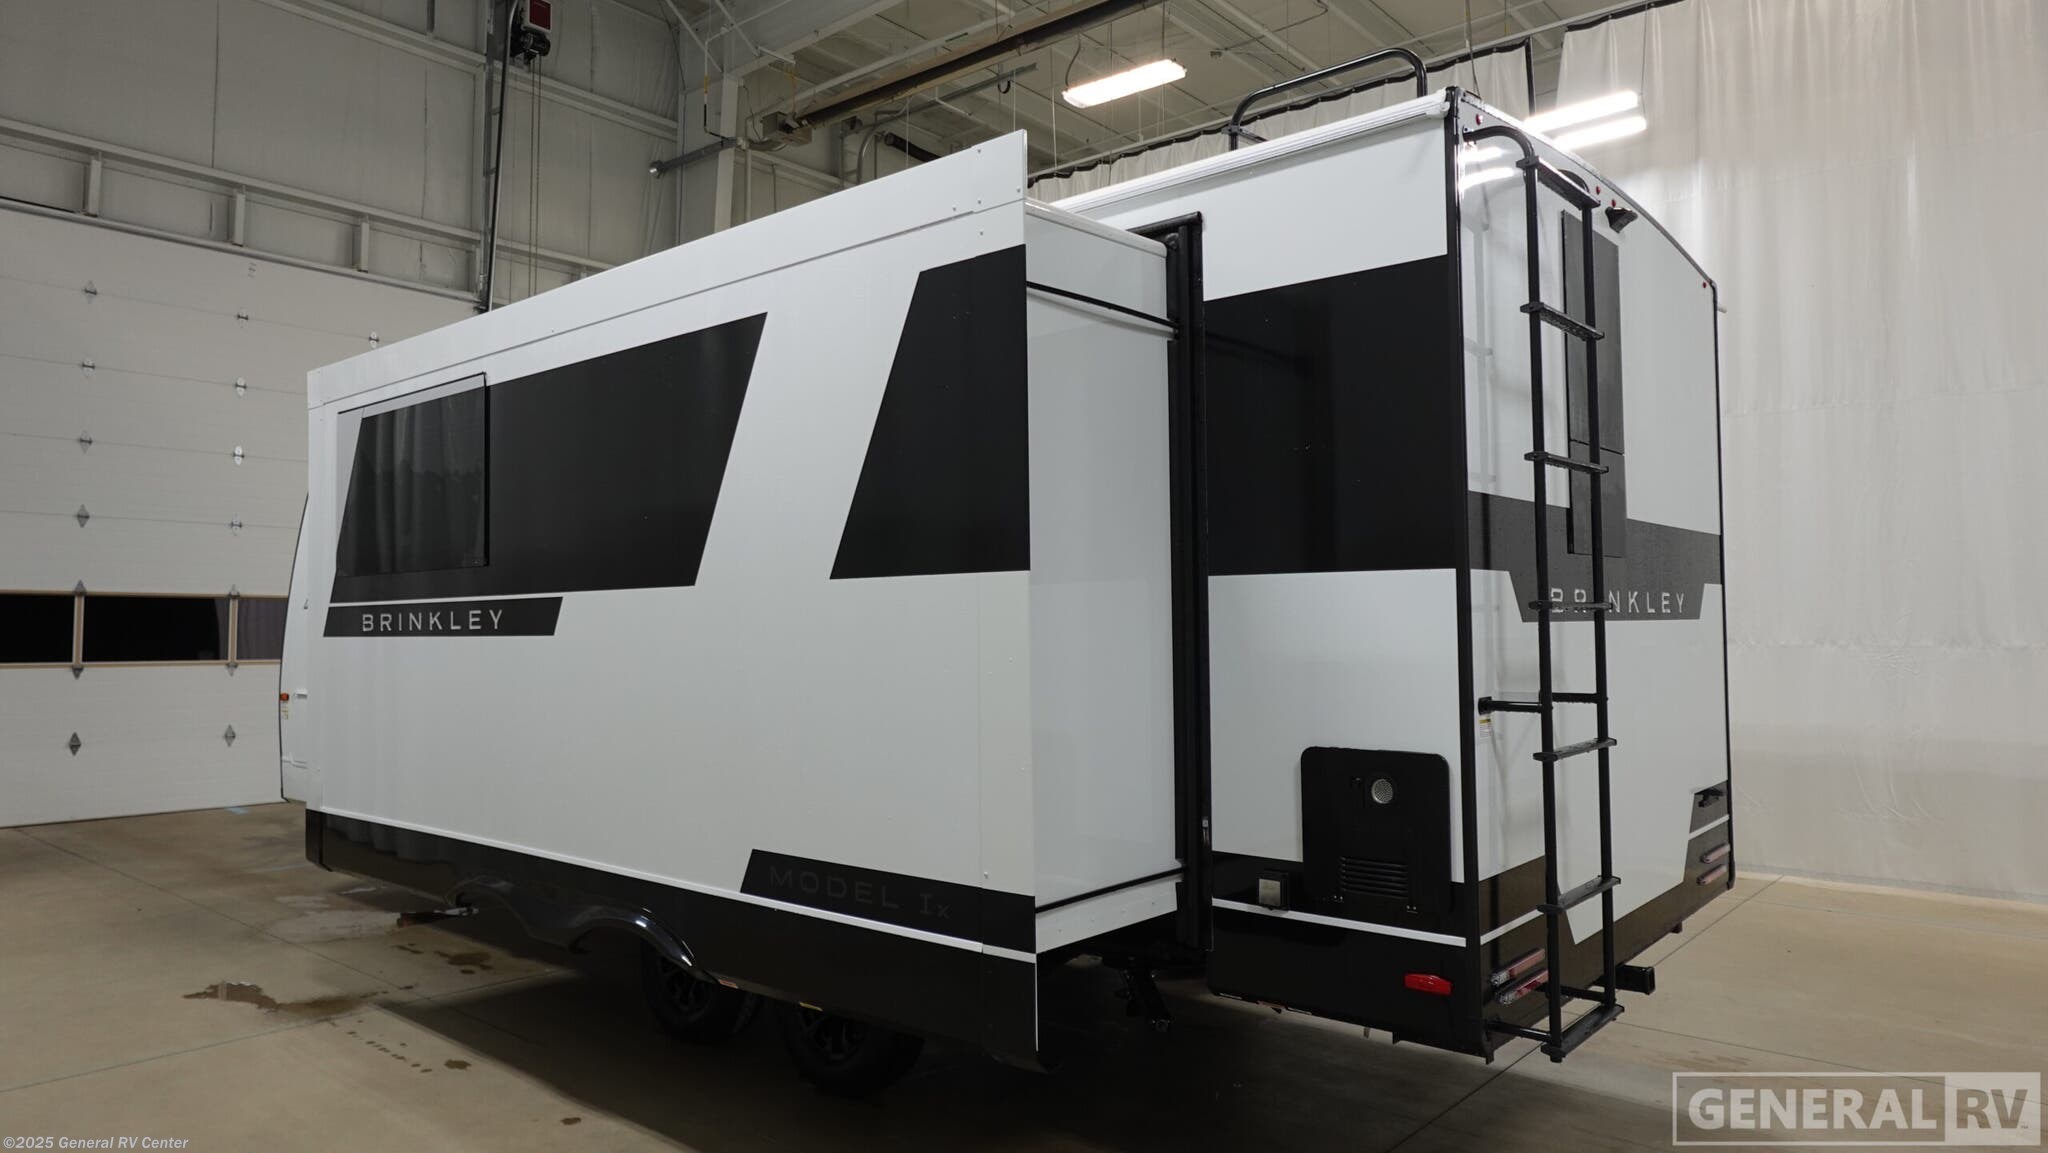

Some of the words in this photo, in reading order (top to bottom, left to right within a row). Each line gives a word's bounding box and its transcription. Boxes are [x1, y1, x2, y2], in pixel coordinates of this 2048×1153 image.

[1550, 587, 1685, 614] BRNKLEY
[361, 609, 503, 632] BRINKLEY
[769, 865, 899, 910] MODEL
